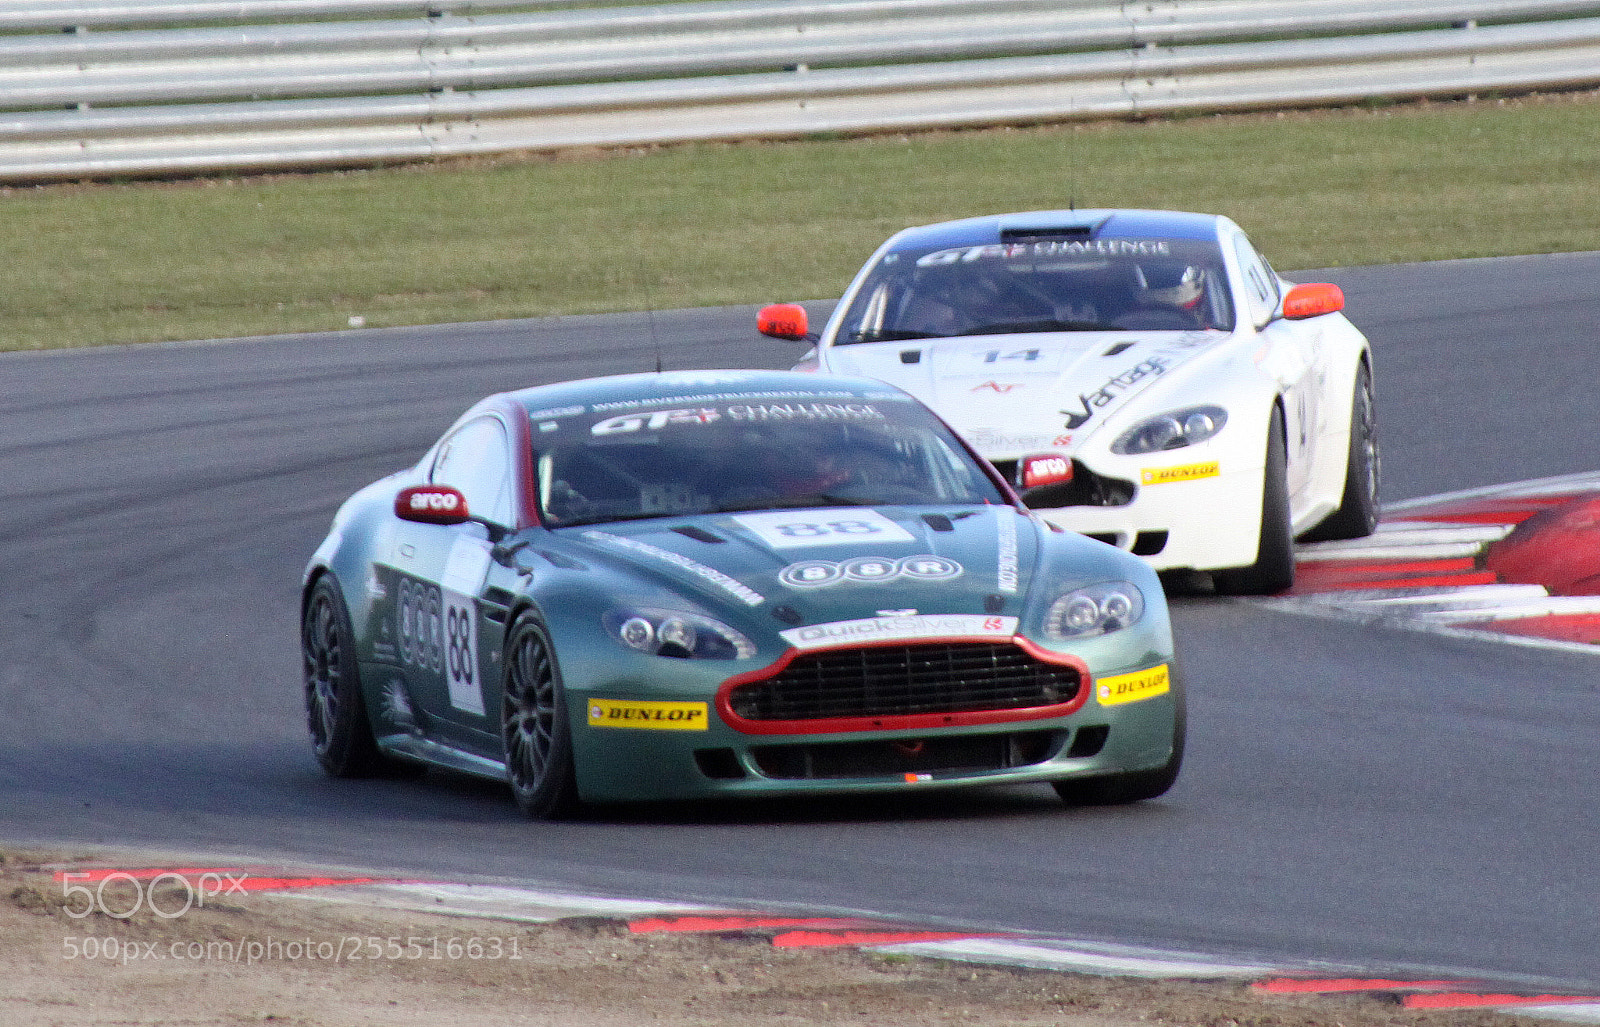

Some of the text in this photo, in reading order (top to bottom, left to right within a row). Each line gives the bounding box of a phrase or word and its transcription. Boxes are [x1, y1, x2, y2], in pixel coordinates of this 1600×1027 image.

[1033, 240, 1170, 257] CHALLENGE
[727, 403, 886, 421] CHALLENGE
[1030, 458, 1068, 477] arco
[1159, 464, 1218, 479] DUNLOP
[409, 492, 459, 510] arco
[776, 520, 882, 537] 88
[448, 605, 473, 685] 88
[1116, 672, 1167, 695] DUNLOP
[607, 706, 702, 721] DUNLOP
